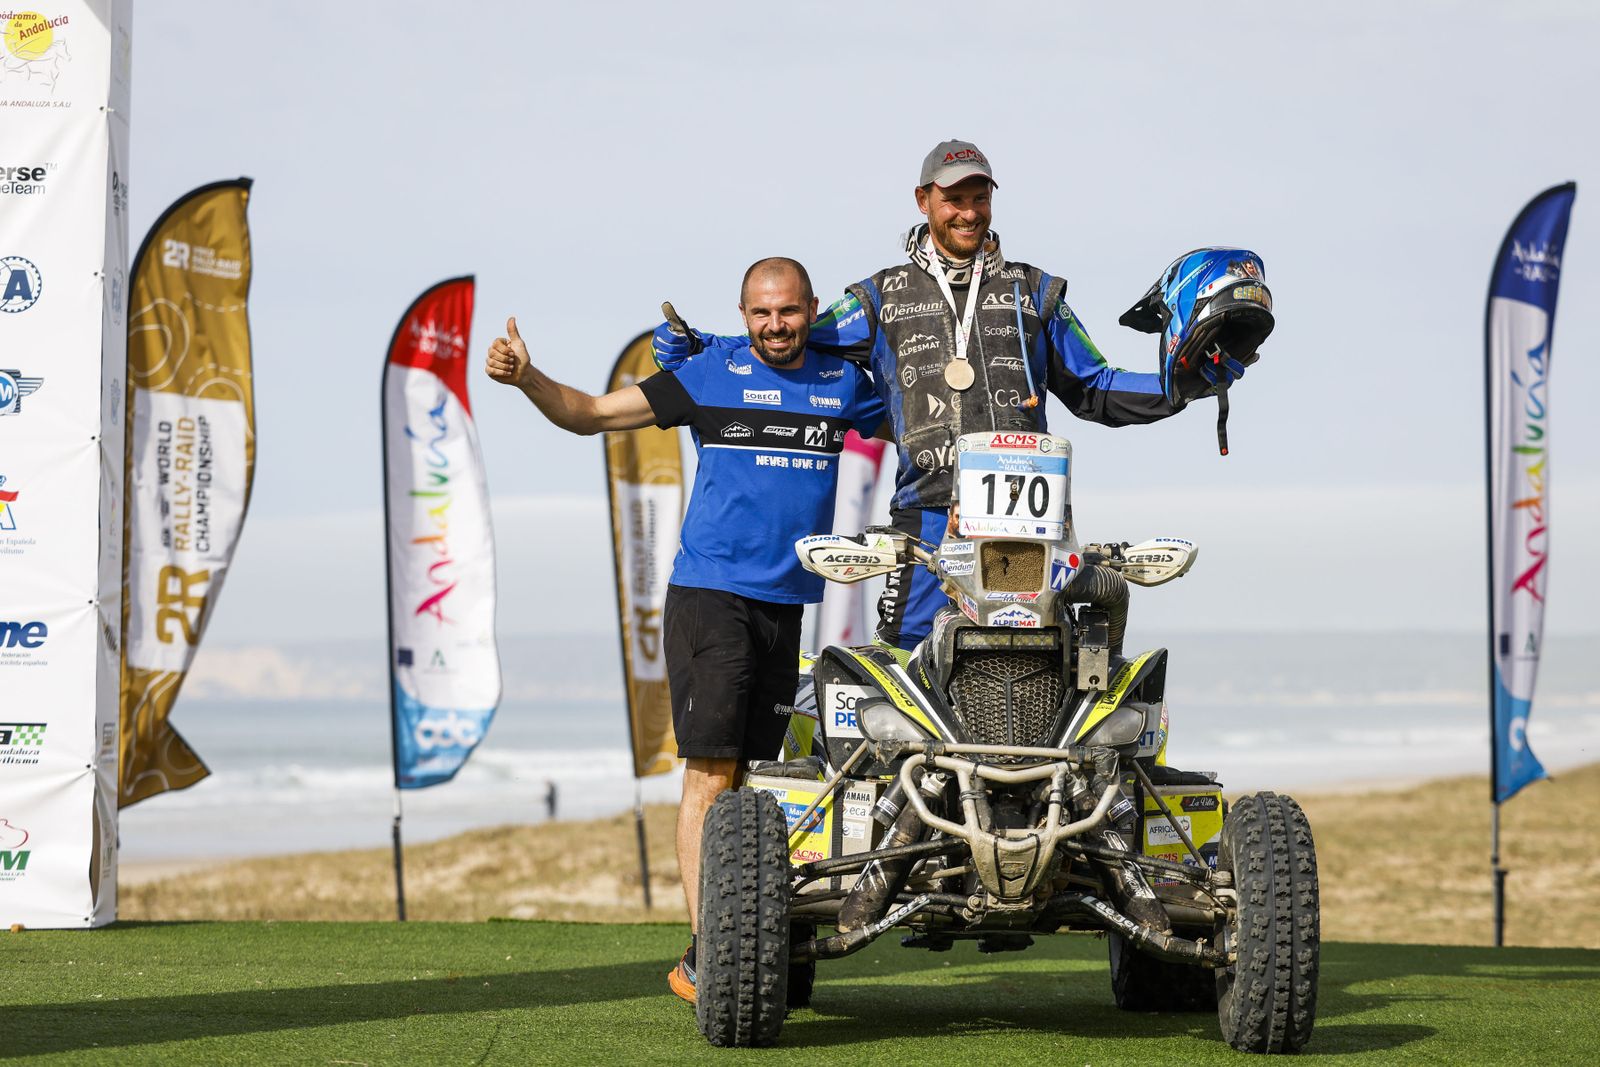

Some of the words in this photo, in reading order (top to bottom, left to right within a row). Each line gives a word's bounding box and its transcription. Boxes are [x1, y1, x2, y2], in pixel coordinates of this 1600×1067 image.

[0, 181, 46, 195] eTeam
[899, 340, 941, 358] ALPESMAT
[745, 392, 780, 401] SOBECA
[991, 433, 1038, 445] ACMS
[157, 420, 173, 485] WORLD
[755, 455, 789, 467] NEVER
[792, 458, 813, 469] GIVE
[816, 460, 829, 470] UP
[173, 416, 196, 553] RALLY-RAID
[196, 415, 213, 553] CHAMPIONSHIP
[981, 473, 1050, 519] 170
[822, 554, 882, 564] ACERBIS
[992, 619, 1037, 627] ALPESMAT
[849, 806, 866, 817] eca
[1149, 825, 1177, 835] AFRIQU
[792, 848, 824, 860] ACMS
